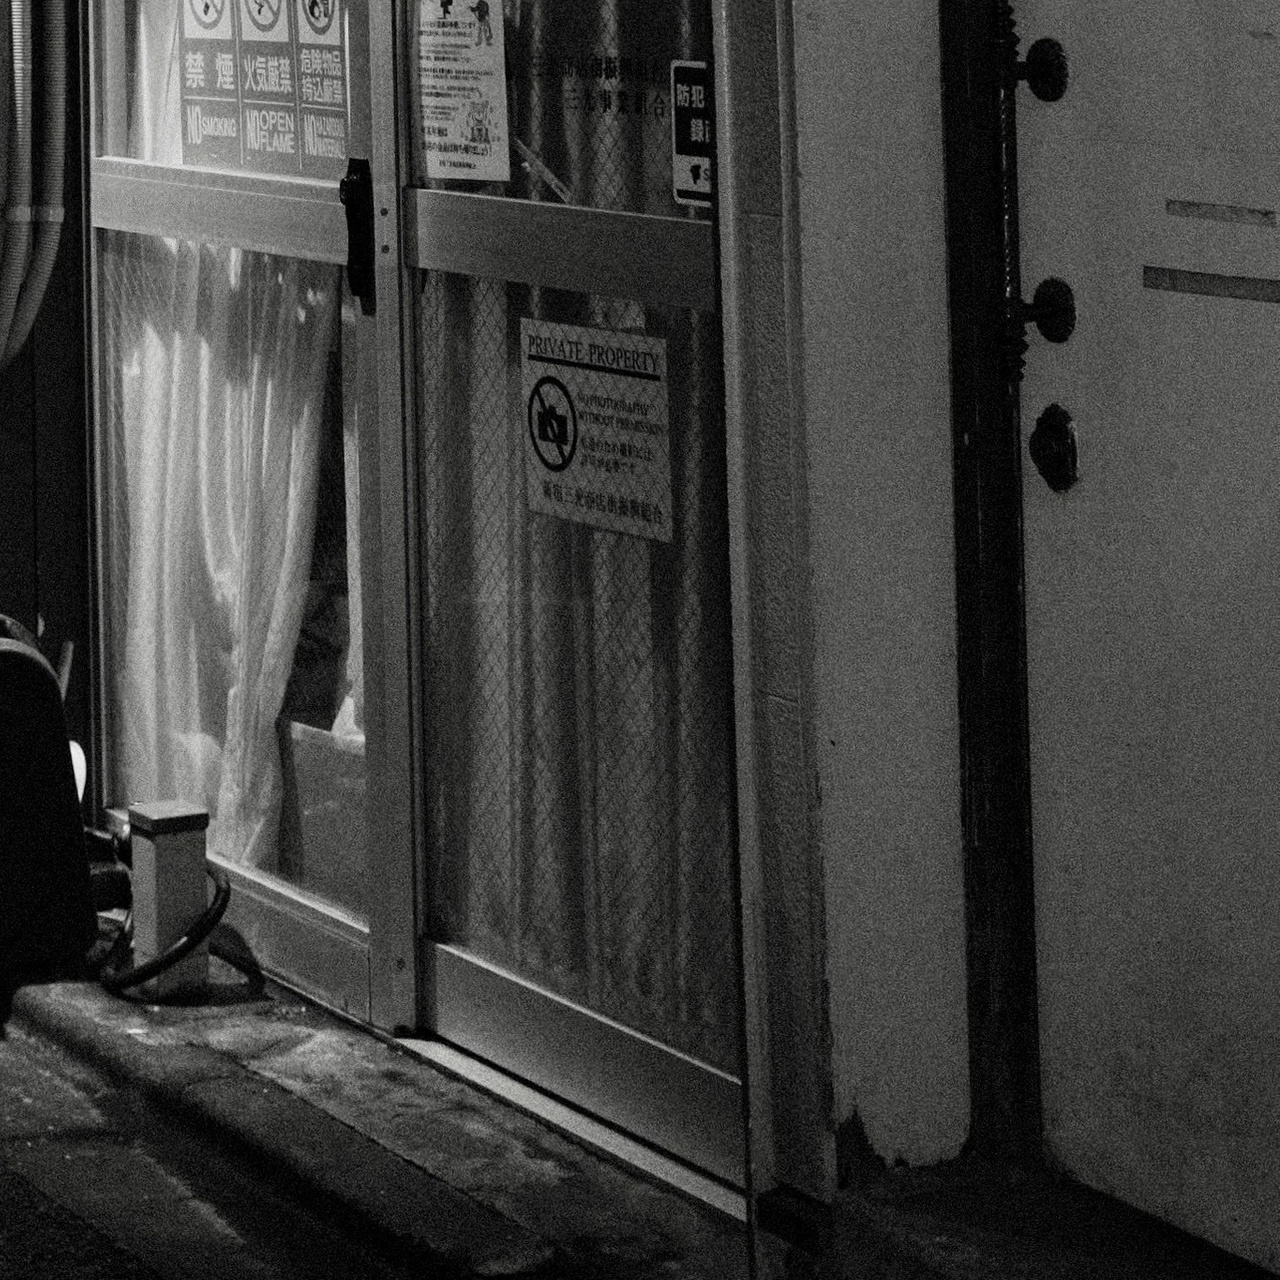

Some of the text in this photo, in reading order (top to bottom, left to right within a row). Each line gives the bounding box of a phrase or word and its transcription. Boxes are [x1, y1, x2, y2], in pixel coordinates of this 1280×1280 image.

[185, 51, 235, 90] 禁煙
[244, 55, 293, 93] 火気厳禁
[301, 48, 342, 77] 危険物品
[301, 75, 344, 105] 持込厳禁
[186, 105, 238, 145] NO SMOKING
[245, 109, 295, 151] NO OPEN
[260, 132, 296, 154] FLAME
[304, 114, 318, 156] NO
[527, 334, 660, 373] PRIVATE PROPERTY
